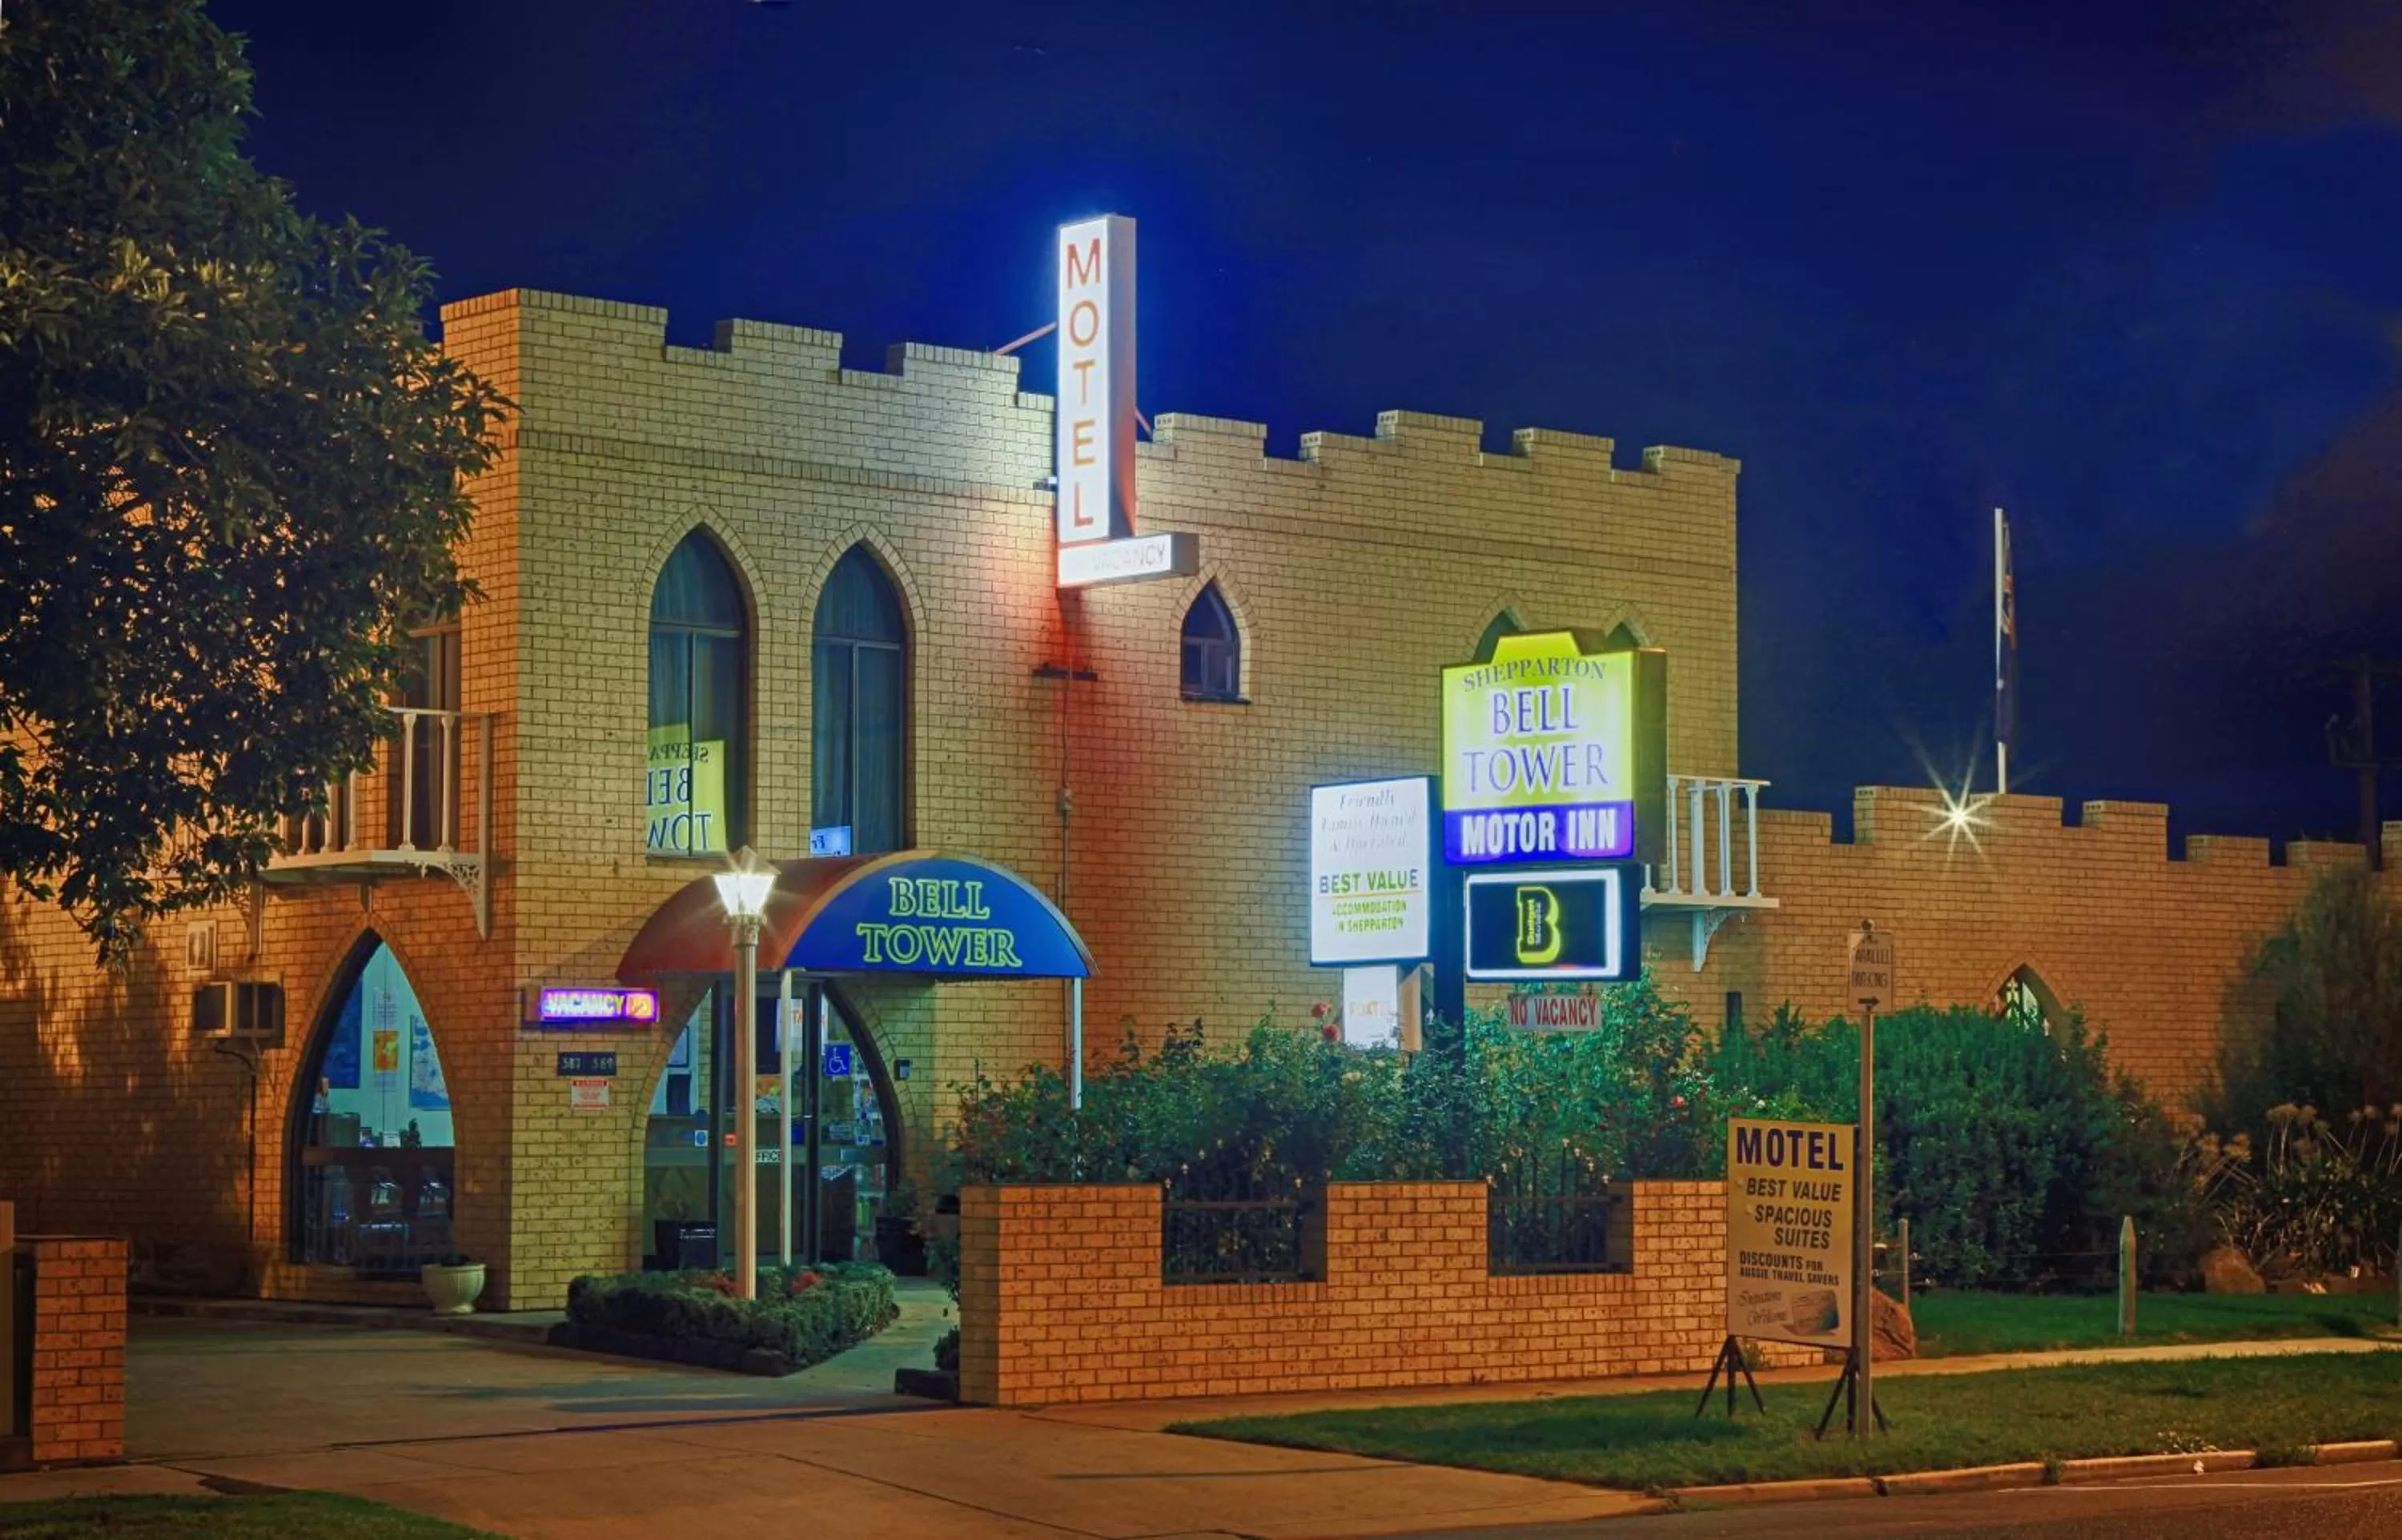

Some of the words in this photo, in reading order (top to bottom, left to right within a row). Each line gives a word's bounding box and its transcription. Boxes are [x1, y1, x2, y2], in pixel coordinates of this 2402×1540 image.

[1066, 238, 1101, 527] MOTEL
[1464, 656, 1607, 692] SHEPPARTON
[1493, 687, 1579, 735] BELL
[1463, 744, 1608, 793] TOWER
[1462, 812, 1556, 855] MOTOR
[1568, 808, 1616, 850] INN
[1319, 872, 1361, 894] BEST
[1368, 868, 1419, 891] VALUE
[889, 876, 990, 920] BELL
[1348, 916, 1404, 933] SHEPPARTON
[856, 922, 1023, 967] TOWER
[547, 993, 625, 1016] VACANCY
[1511, 998, 1528, 1025] NO
[1534, 998, 1597, 1025] VACANCY
[1737, 1126, 1844, 1170] MOTEL
[1746, 1177, 1787, 1197] BEST
[1793, 1181, 1842, 1201] VALUE
[1754, 1204, 1833, 1229] SPACIOUS
[1773, 1227, 1831, 1250] SUITES
[1739, 1250, 1803, 1270] DISCOUNTS
[1806, 1259, 1823, 1271] FOR
[1739, 1267, 1769, 1279] AUSSIE
[1772, 1269, 1804, 1282] TRAVEL
[1807, 1273, 1840, 1285] SAVERS
